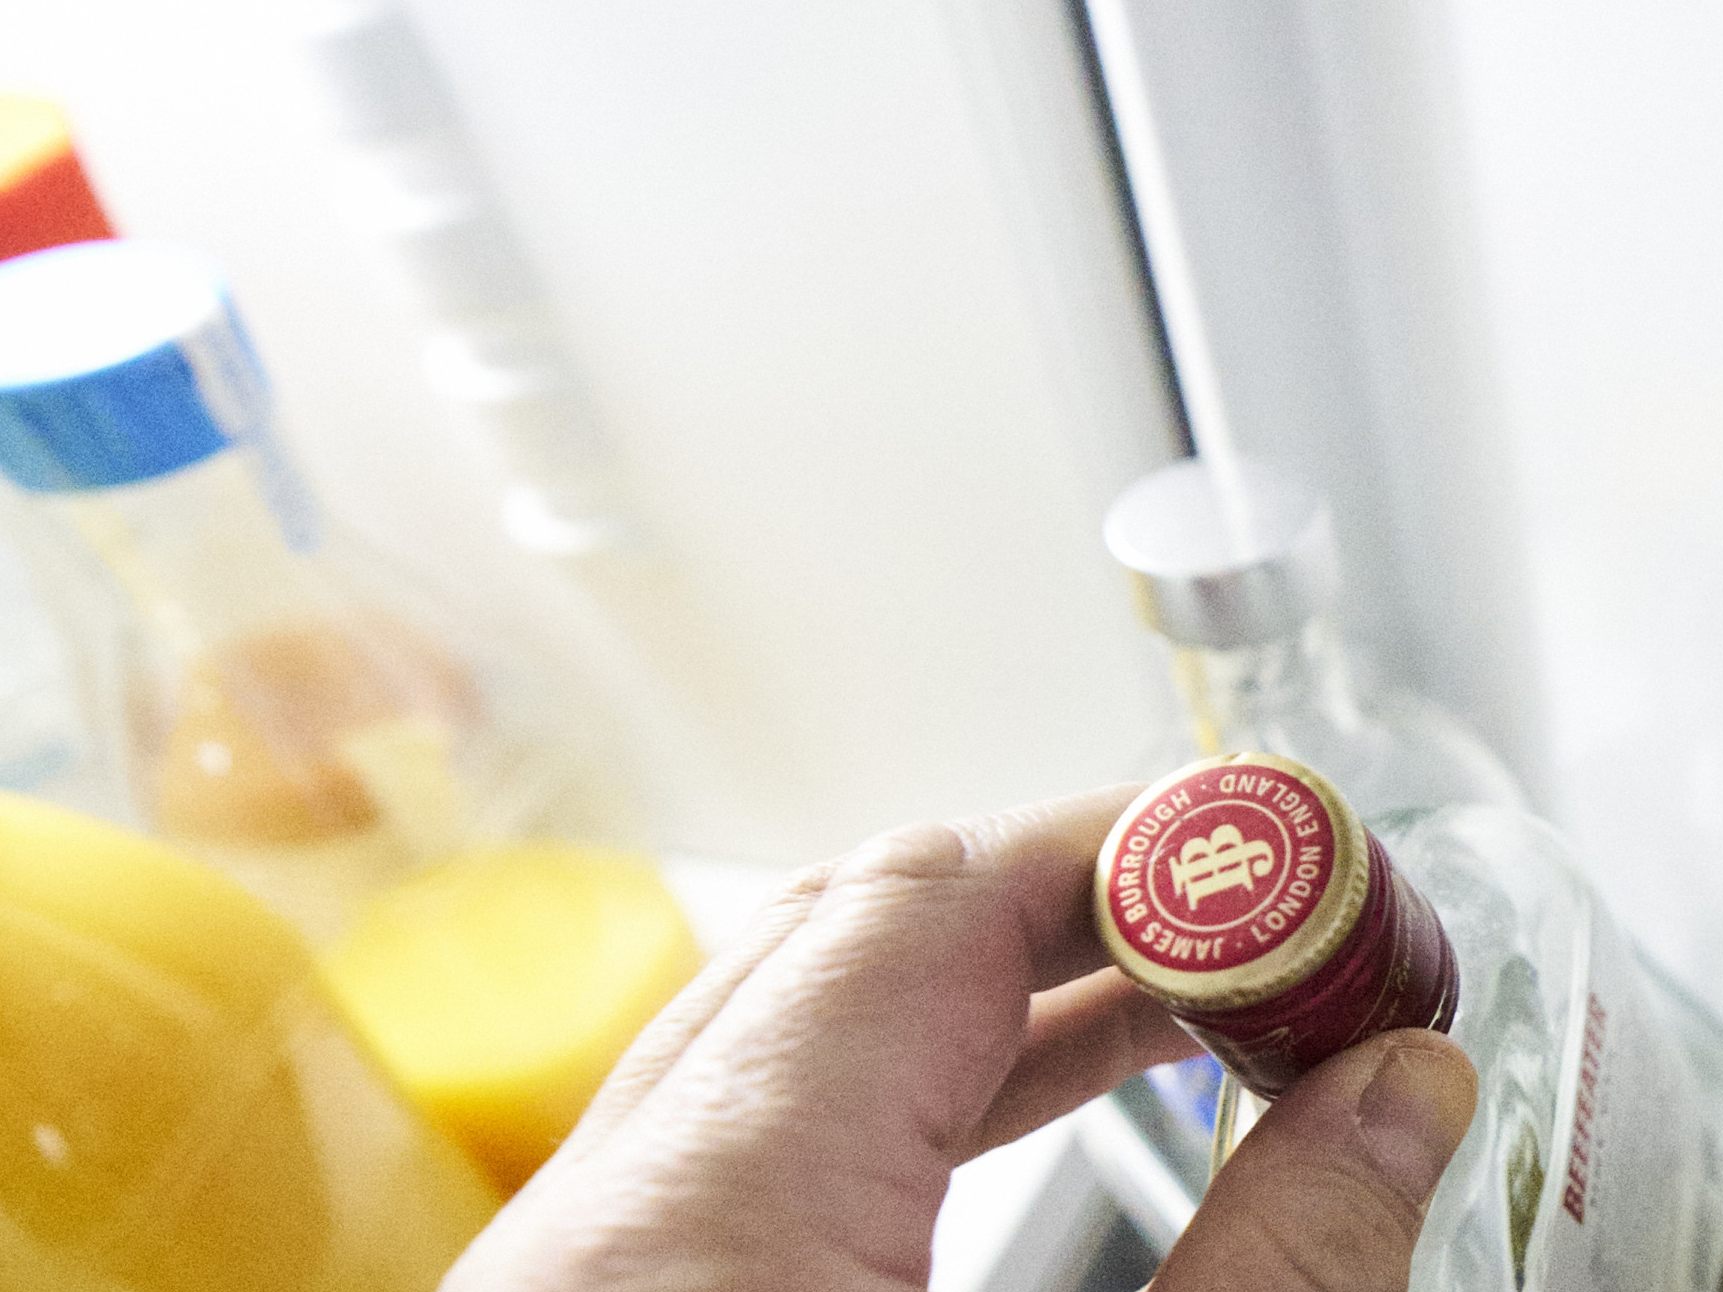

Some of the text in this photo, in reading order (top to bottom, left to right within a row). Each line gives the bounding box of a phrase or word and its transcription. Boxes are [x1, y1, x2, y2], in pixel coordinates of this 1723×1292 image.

[1119, 789, 1225, 962] JAMES BURROUGH
[1219, 773, 1323, 944] LONDON ENGLAND
